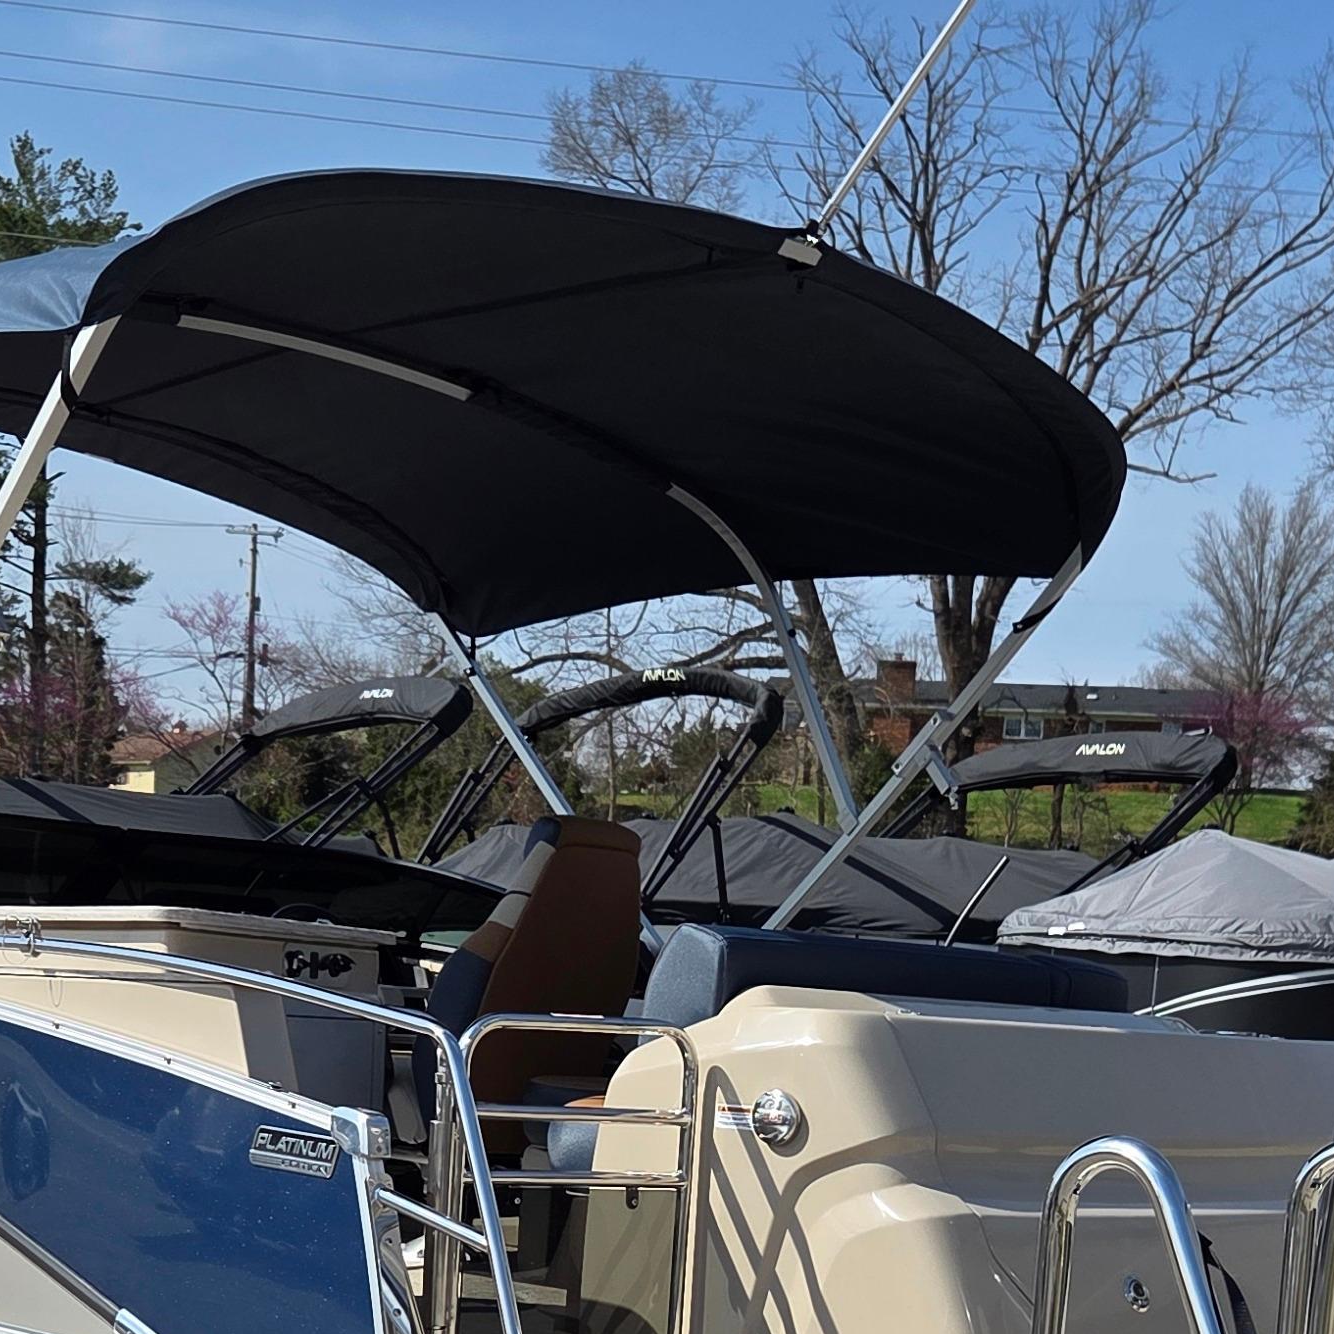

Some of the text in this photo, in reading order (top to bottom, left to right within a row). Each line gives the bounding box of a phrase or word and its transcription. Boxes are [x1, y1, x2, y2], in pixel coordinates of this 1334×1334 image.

[642, 668, 686, 682] AVALON
[1075, 743, 1126, 756] AVALON
[255, 1132, 336, 1160] PLATINUM
